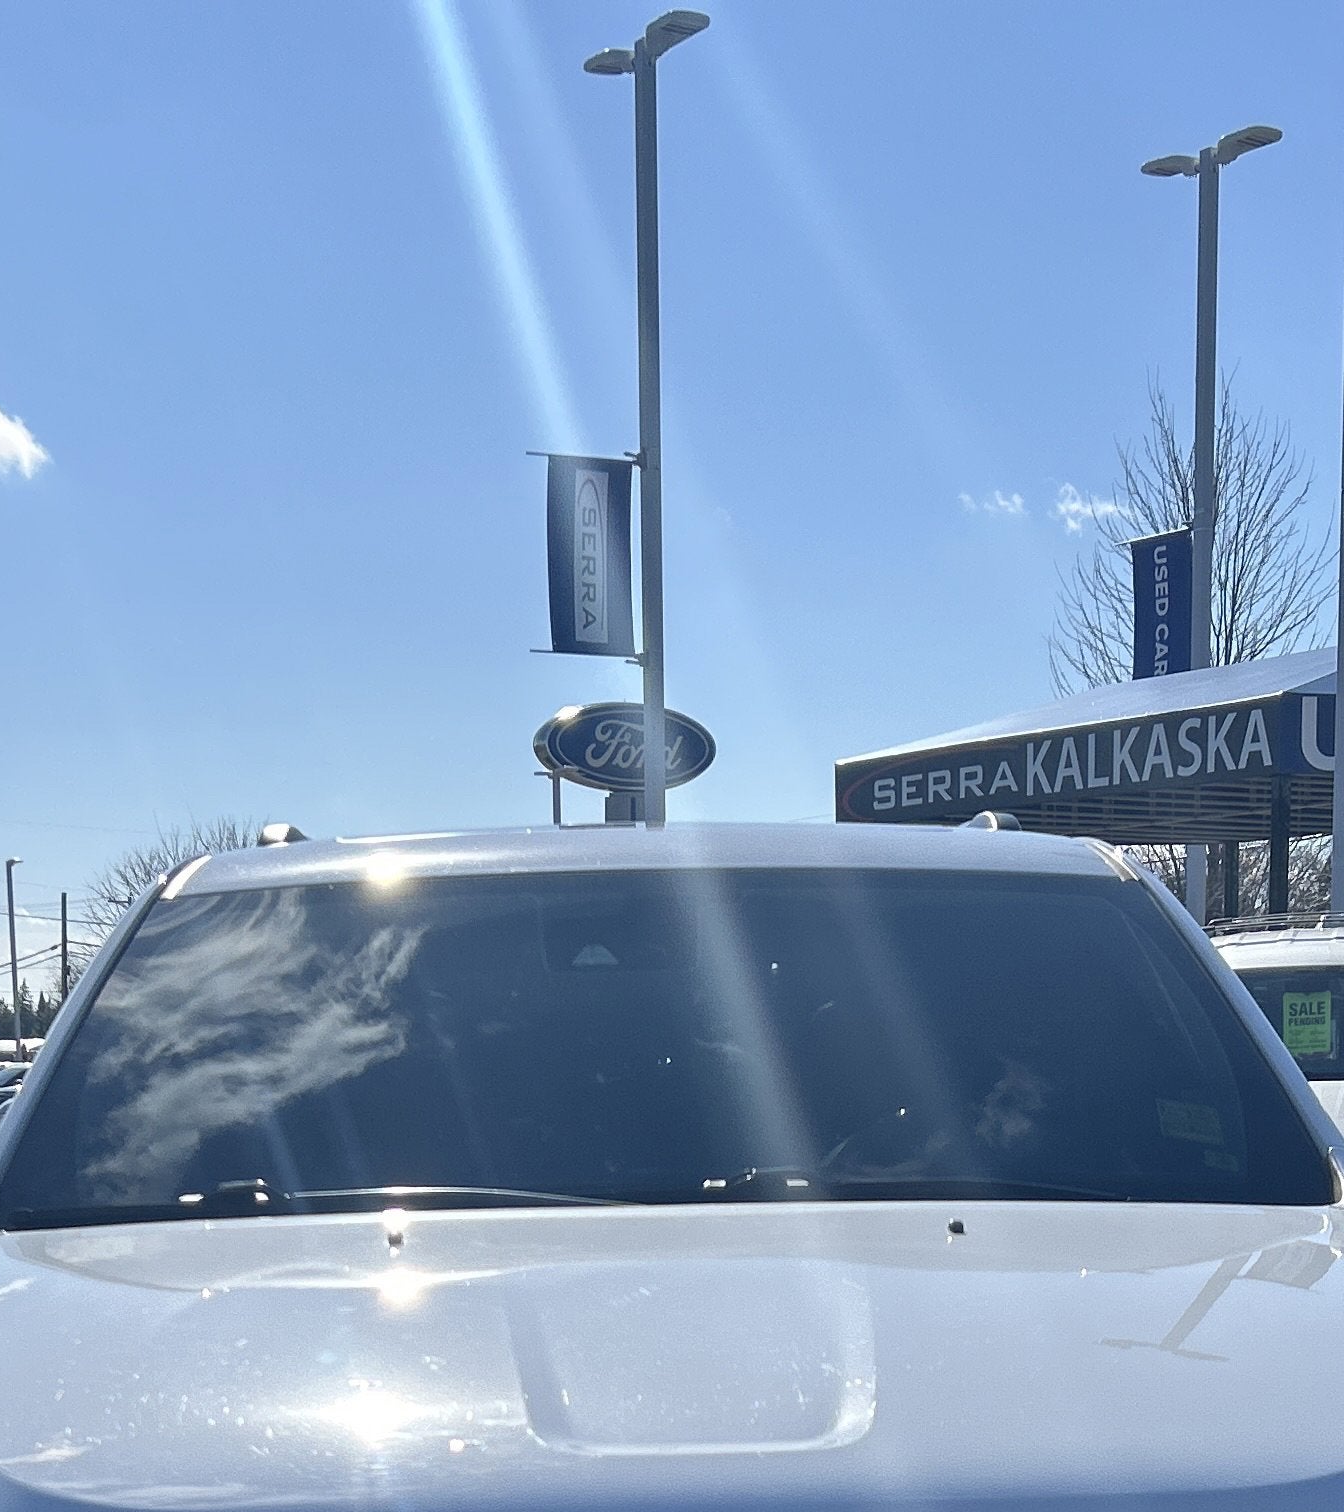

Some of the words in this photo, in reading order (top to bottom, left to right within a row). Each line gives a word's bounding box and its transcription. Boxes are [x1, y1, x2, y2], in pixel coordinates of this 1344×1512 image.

[581, 506, 597, 631] SERRA
[1153, 545, 1169, 617] USED
[1153, 623, 1169, 676] CAR
[873, 760, 1019, 810] SERRA
[1026, 708, 1273, 796] KALKASKA
[1288, 1001, 1326, 1017] SALE
